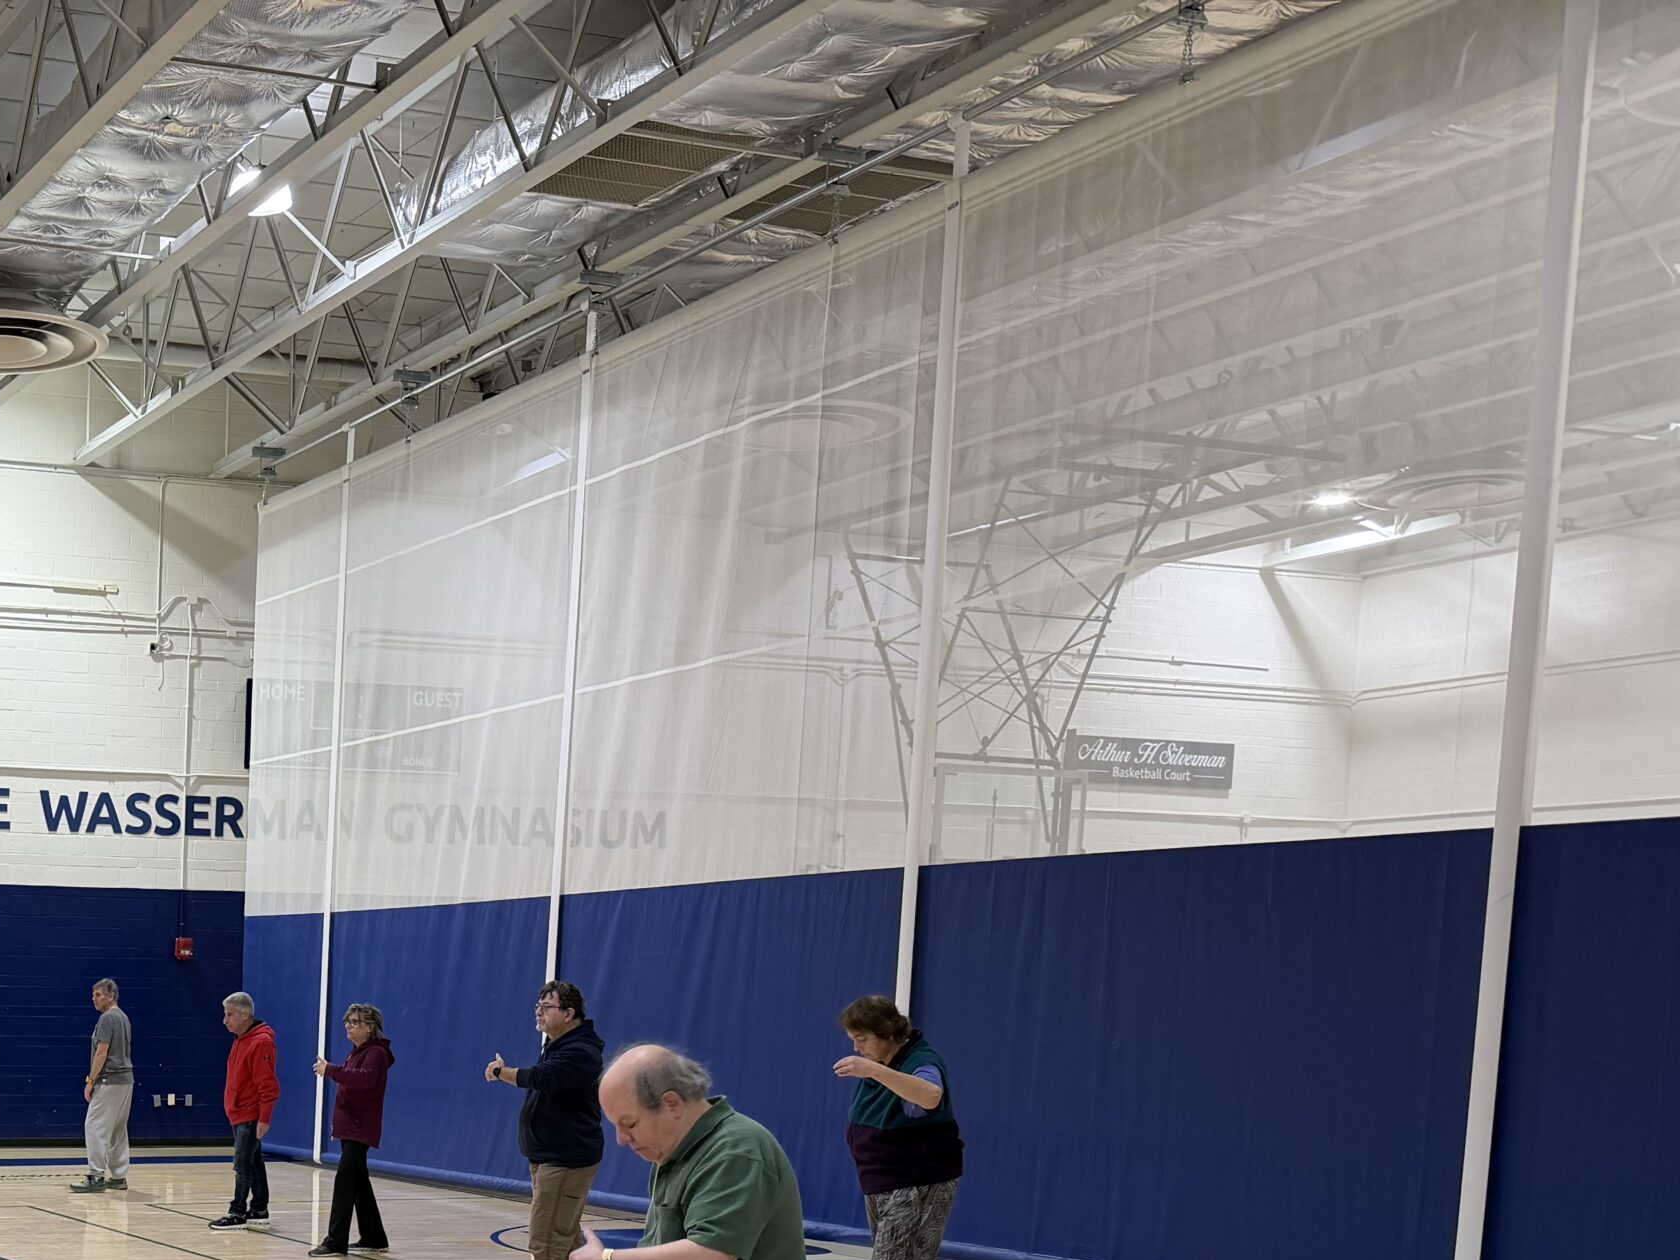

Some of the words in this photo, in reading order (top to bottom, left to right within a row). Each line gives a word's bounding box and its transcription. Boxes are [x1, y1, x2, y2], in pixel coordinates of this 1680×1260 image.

[258, 682, 306, 702] HOME
[412, 690, 463, 709] GUEST
[1078, 738, 1132, 763] Arthur
[1134, 741, 1166, 765] H.
[1159, 742, 1228, 769] Silverman
[1112, 766, 1162, 780] Basketball
[1164, 769, 1191, 782] Court
